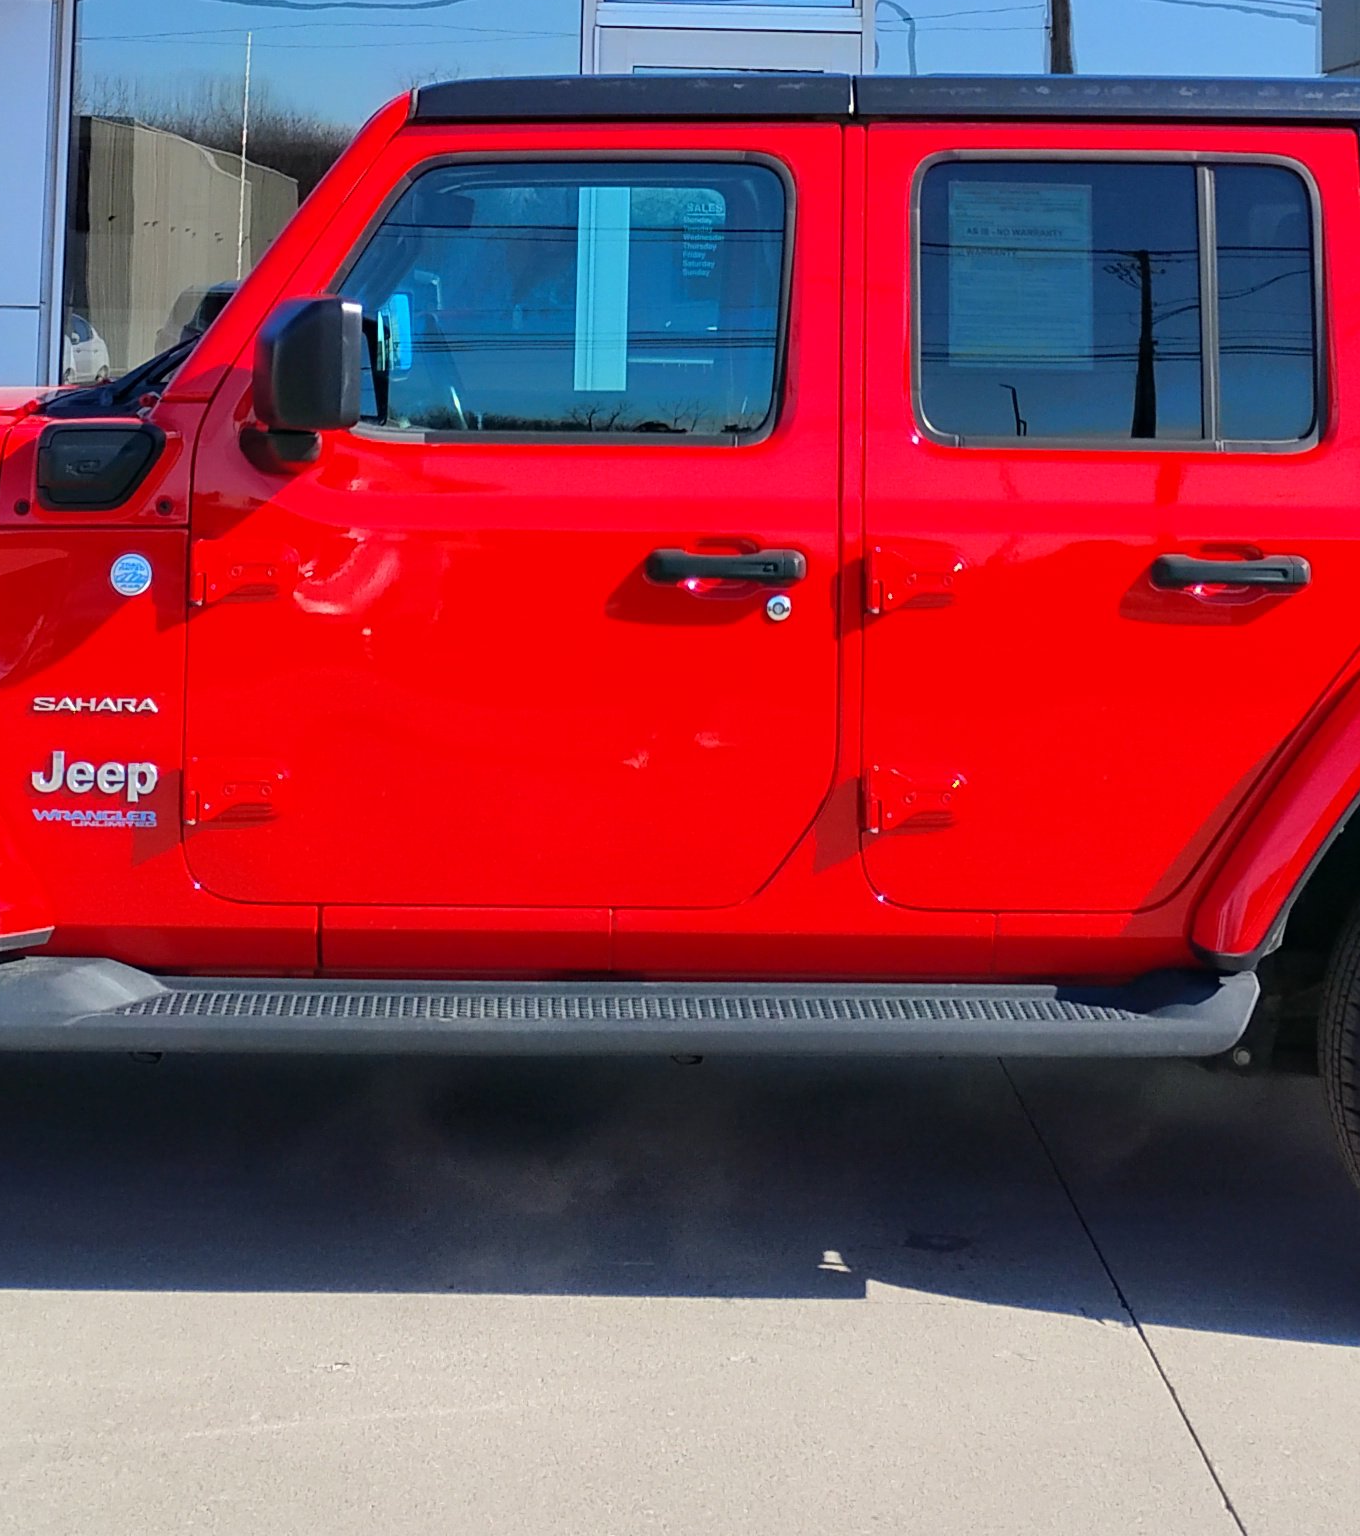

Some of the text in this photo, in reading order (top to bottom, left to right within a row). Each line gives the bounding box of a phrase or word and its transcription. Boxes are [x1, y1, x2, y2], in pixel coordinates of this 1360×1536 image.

[33, 696, 159, 713] SAHARA
[31, 750, 158, 802] Jeep
[32, 808, 157, 822] WRANGLER
[71, 819, 157, 828] UNLIMITED
